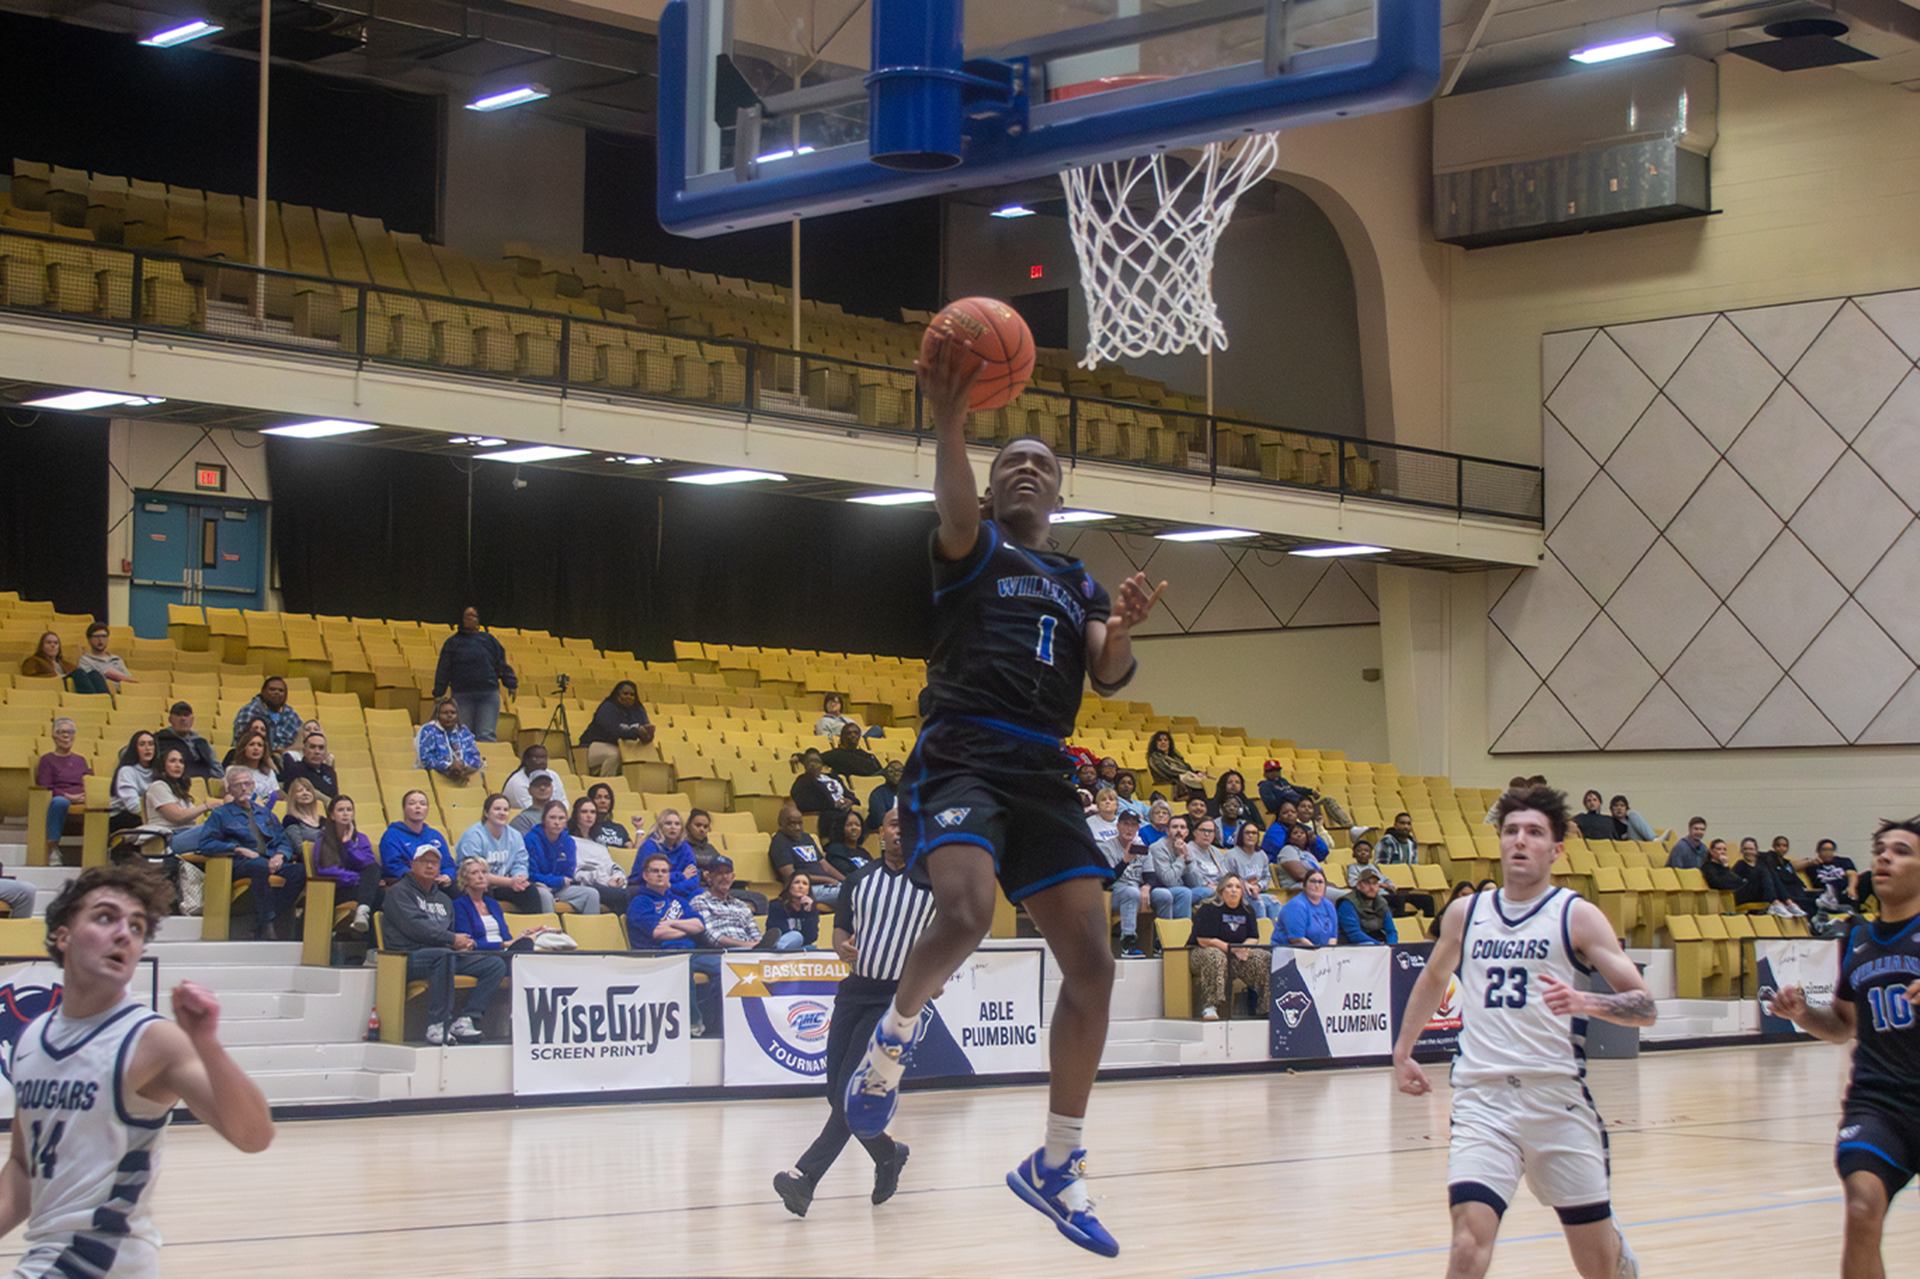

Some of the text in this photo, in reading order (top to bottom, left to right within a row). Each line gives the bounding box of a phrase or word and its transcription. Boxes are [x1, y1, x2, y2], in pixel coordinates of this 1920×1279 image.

[201, 470, 217, 485] EXIT
[1036, 614, 1058, 666] 1
[1472, 939, 1550, 959] COUGARS
[763, 963, 849, 978] BASKETBALL
[1484, 966, 1528, 1008] 23
[979, 1001, 1014, 1021] ABLE
[1342, 992, 1372, 1010] ABLE
[1867, 983, 1914, 1031] 10
[523, 985, 680, 1054] WiseGuys
[790, 1012, 826, 1030] AMC
[1326, 1013, 1387, 1033] PLUMBING
[962, 1024, 1037, 1047] PLUMBING
[531, 1044, 646, 1060] SCREEN PRINT
[16, 1079, 99, 1111] COUGARS
[31, 1120, 66, 1179] 14
